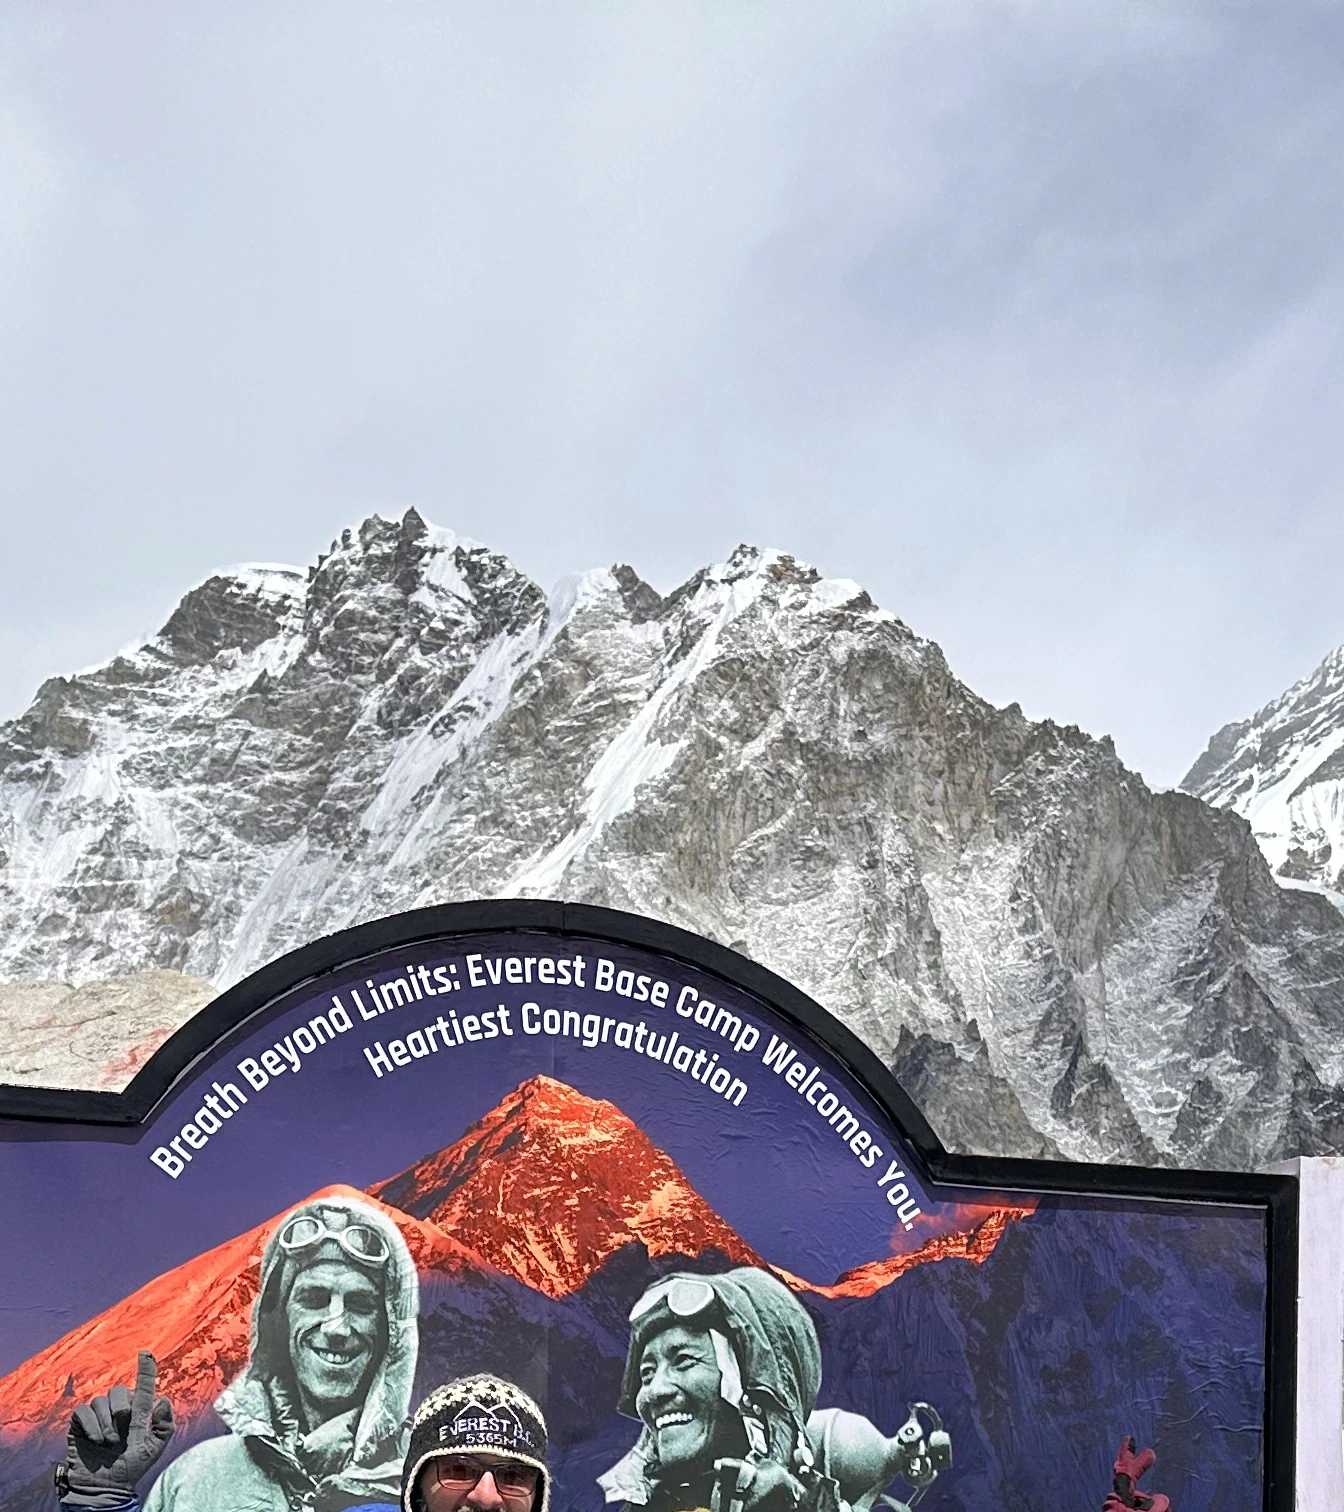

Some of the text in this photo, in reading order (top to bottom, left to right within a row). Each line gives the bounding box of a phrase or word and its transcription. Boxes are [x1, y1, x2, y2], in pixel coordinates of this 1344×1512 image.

[363, 1002, 748, 1107] Heartiest Congratulation
[149, 953, 922, 1230] Breath Beyond Limits: Everest Base Camp Welcomes You.
[438, 1417, 511, 1442] EVEREST
[465, 1432, 517, 1448] 5365M
